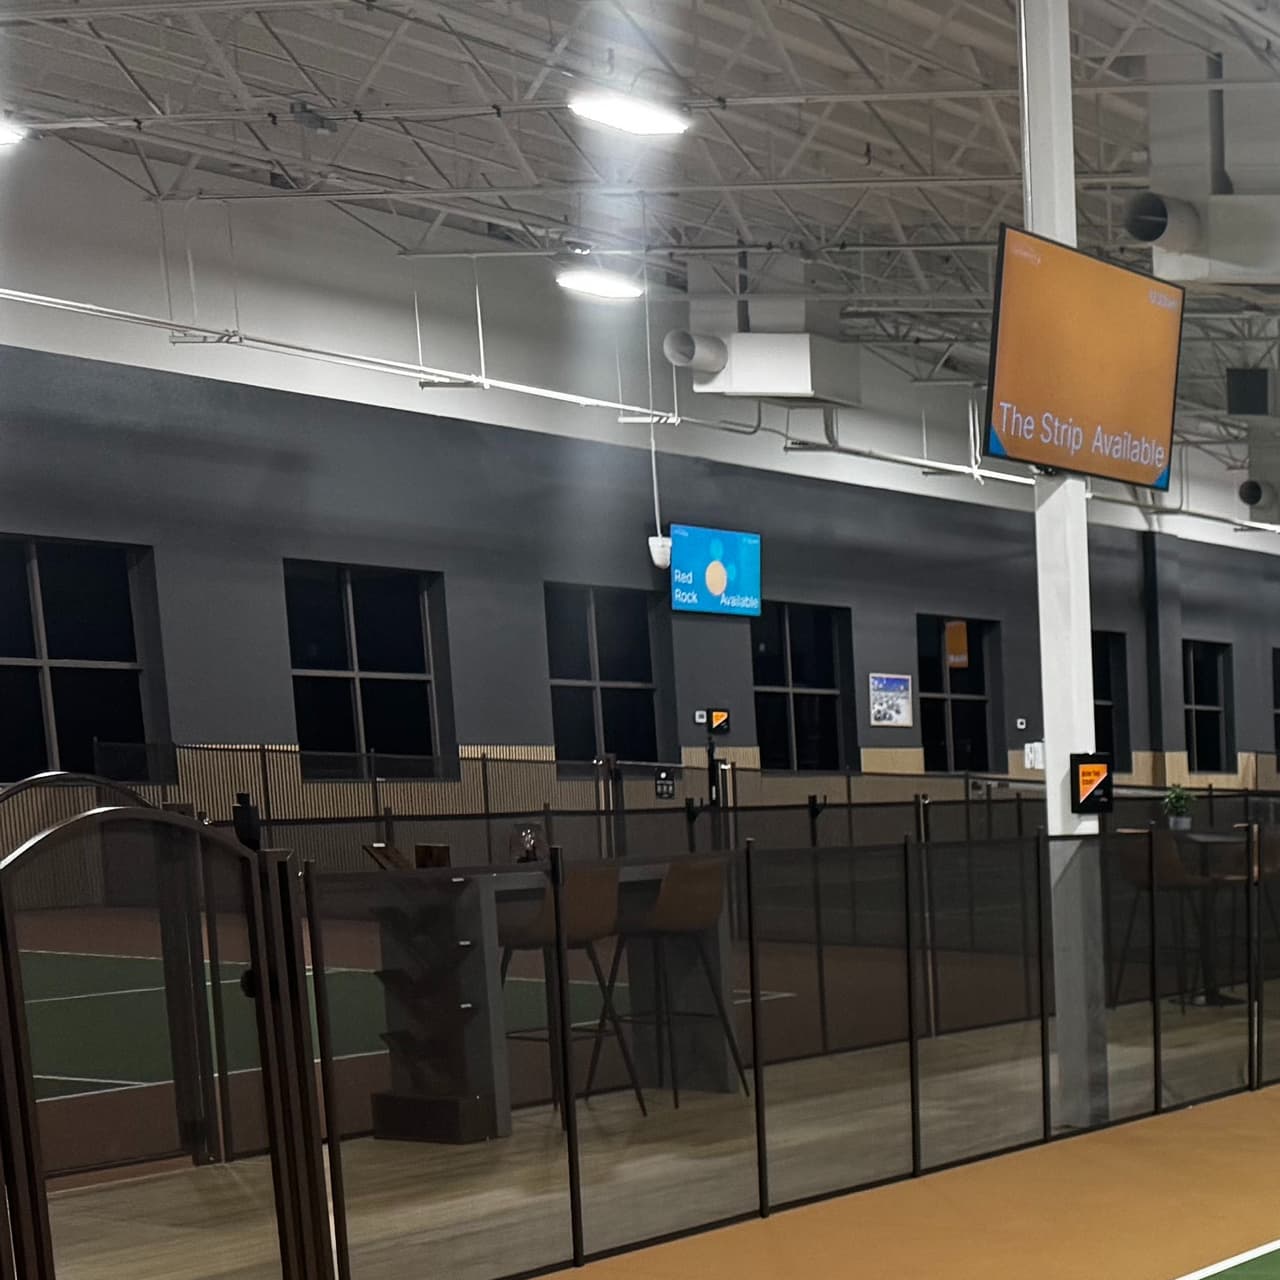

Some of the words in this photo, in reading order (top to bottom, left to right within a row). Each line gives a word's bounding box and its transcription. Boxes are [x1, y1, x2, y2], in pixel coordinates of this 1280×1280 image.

[999, 402, 1035, 440] The
[1040, 412, 1084, 456] Strip
[1091, 425, 1166, 468] Available
[674, 569, 693, 585] Red
[674, 588, 698, 605] Rock
[720, 593, 759, 609] Available
